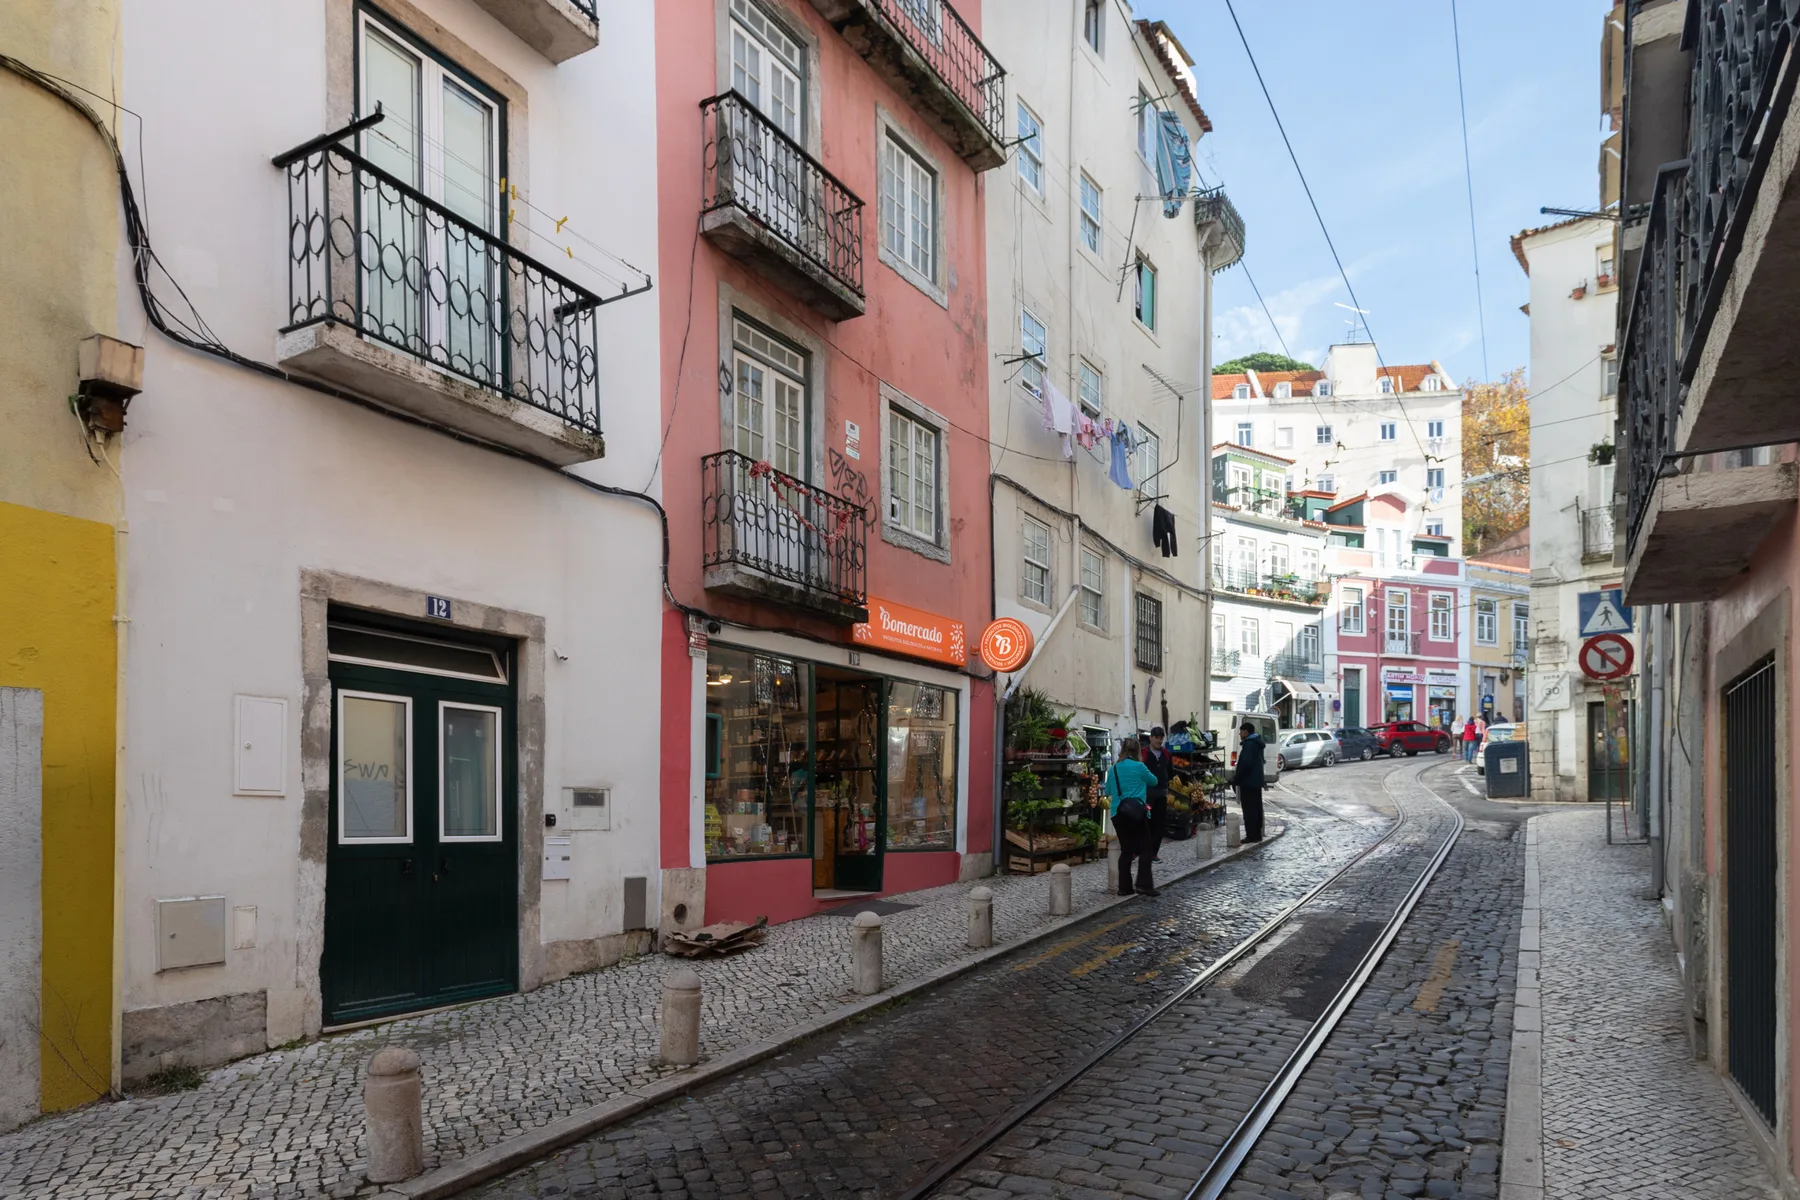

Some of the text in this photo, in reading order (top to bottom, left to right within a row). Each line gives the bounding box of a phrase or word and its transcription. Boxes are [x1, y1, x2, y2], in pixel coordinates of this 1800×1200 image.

[433, 598, 447, 617] 12
[879, 605, 943, 643] Bomercado
[985, 623, 1002, 645] PRODUTOS
[1545, 686, 1560, 696] 30
